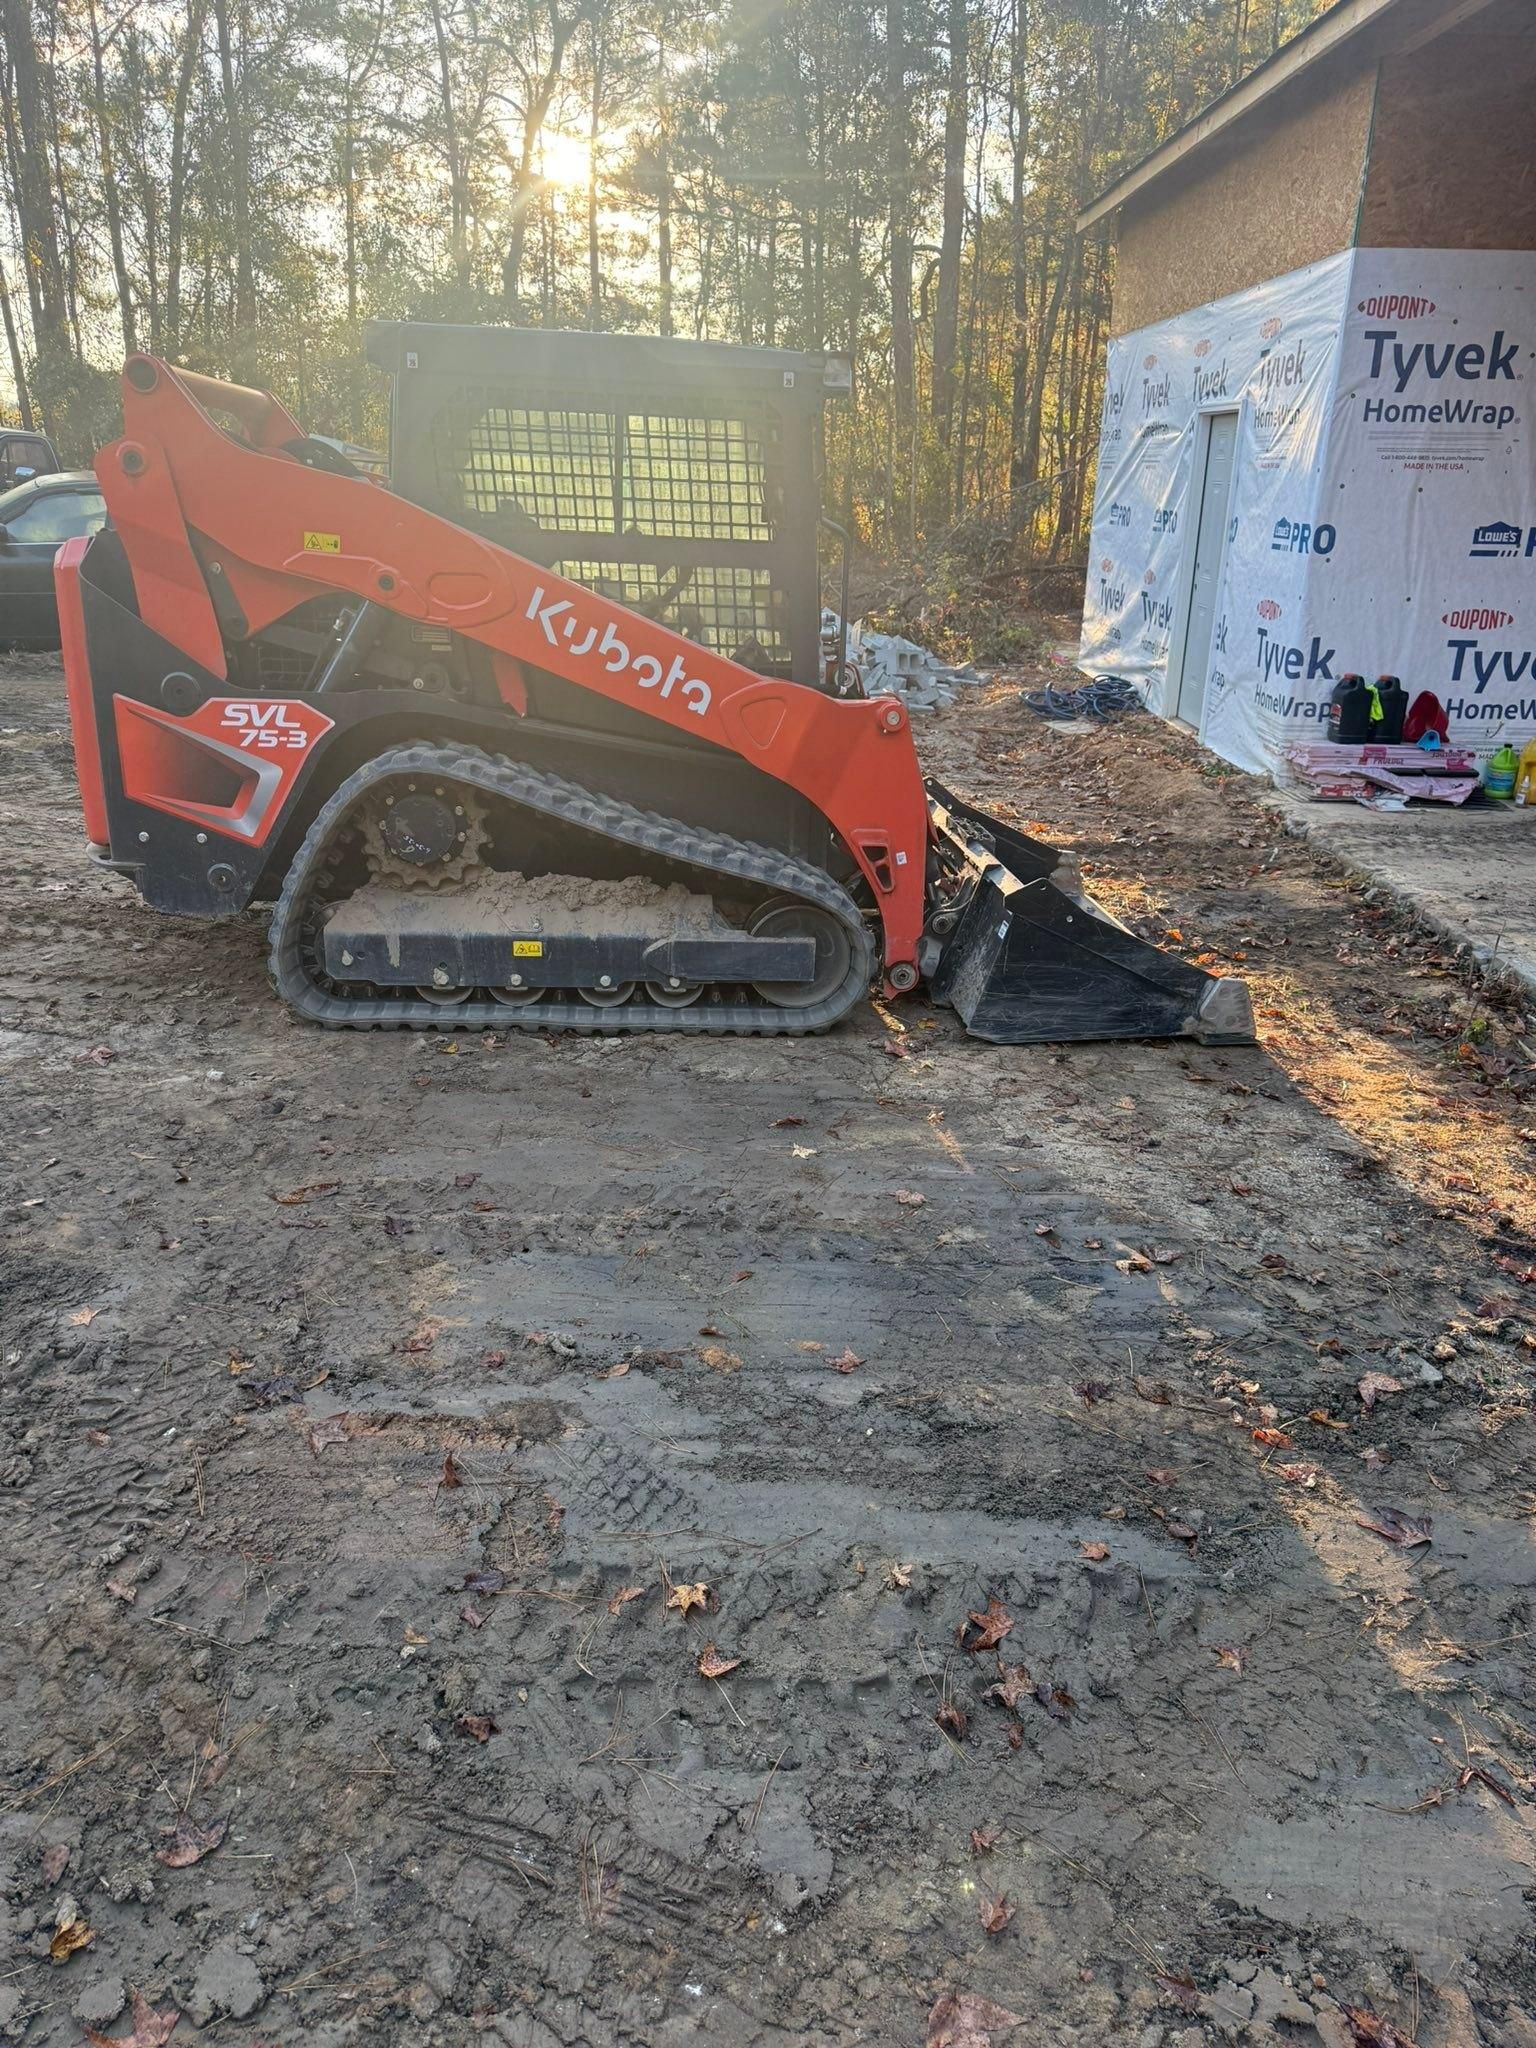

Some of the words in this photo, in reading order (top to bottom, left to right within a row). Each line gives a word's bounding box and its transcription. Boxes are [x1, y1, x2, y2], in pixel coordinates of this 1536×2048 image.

[1366, 295, 1429, 320] DUPONT
[1364, 330, 1520, 393] Tyvek
[1104, 383, 1125, 424] yvek
[1142, 372, 1171, 419] Tyvek
[1363, 399, 1515, 430] HomeWrap
[1289, 522, 1337, 555] PRO
[1478, 530, 1518, 543] LOWE'S
[1101, 578, 1126, 615] Tyvek
[1141, 591, 1173, 632] Tyvek
[1450, 609, 1507, 630] DUPONT
[525, 586, 712, 716] Kubota
[1257, 627, 1336, 683] Tyvek
[1447, 640, 1536, 694] Tyv
[220, 703, 301, 728] SVL
[1254, 684, 1332, 723] HomeWrap
[1447, 698, 1536, 720] HomeW
[239, 729, 308, 748] 75-3
